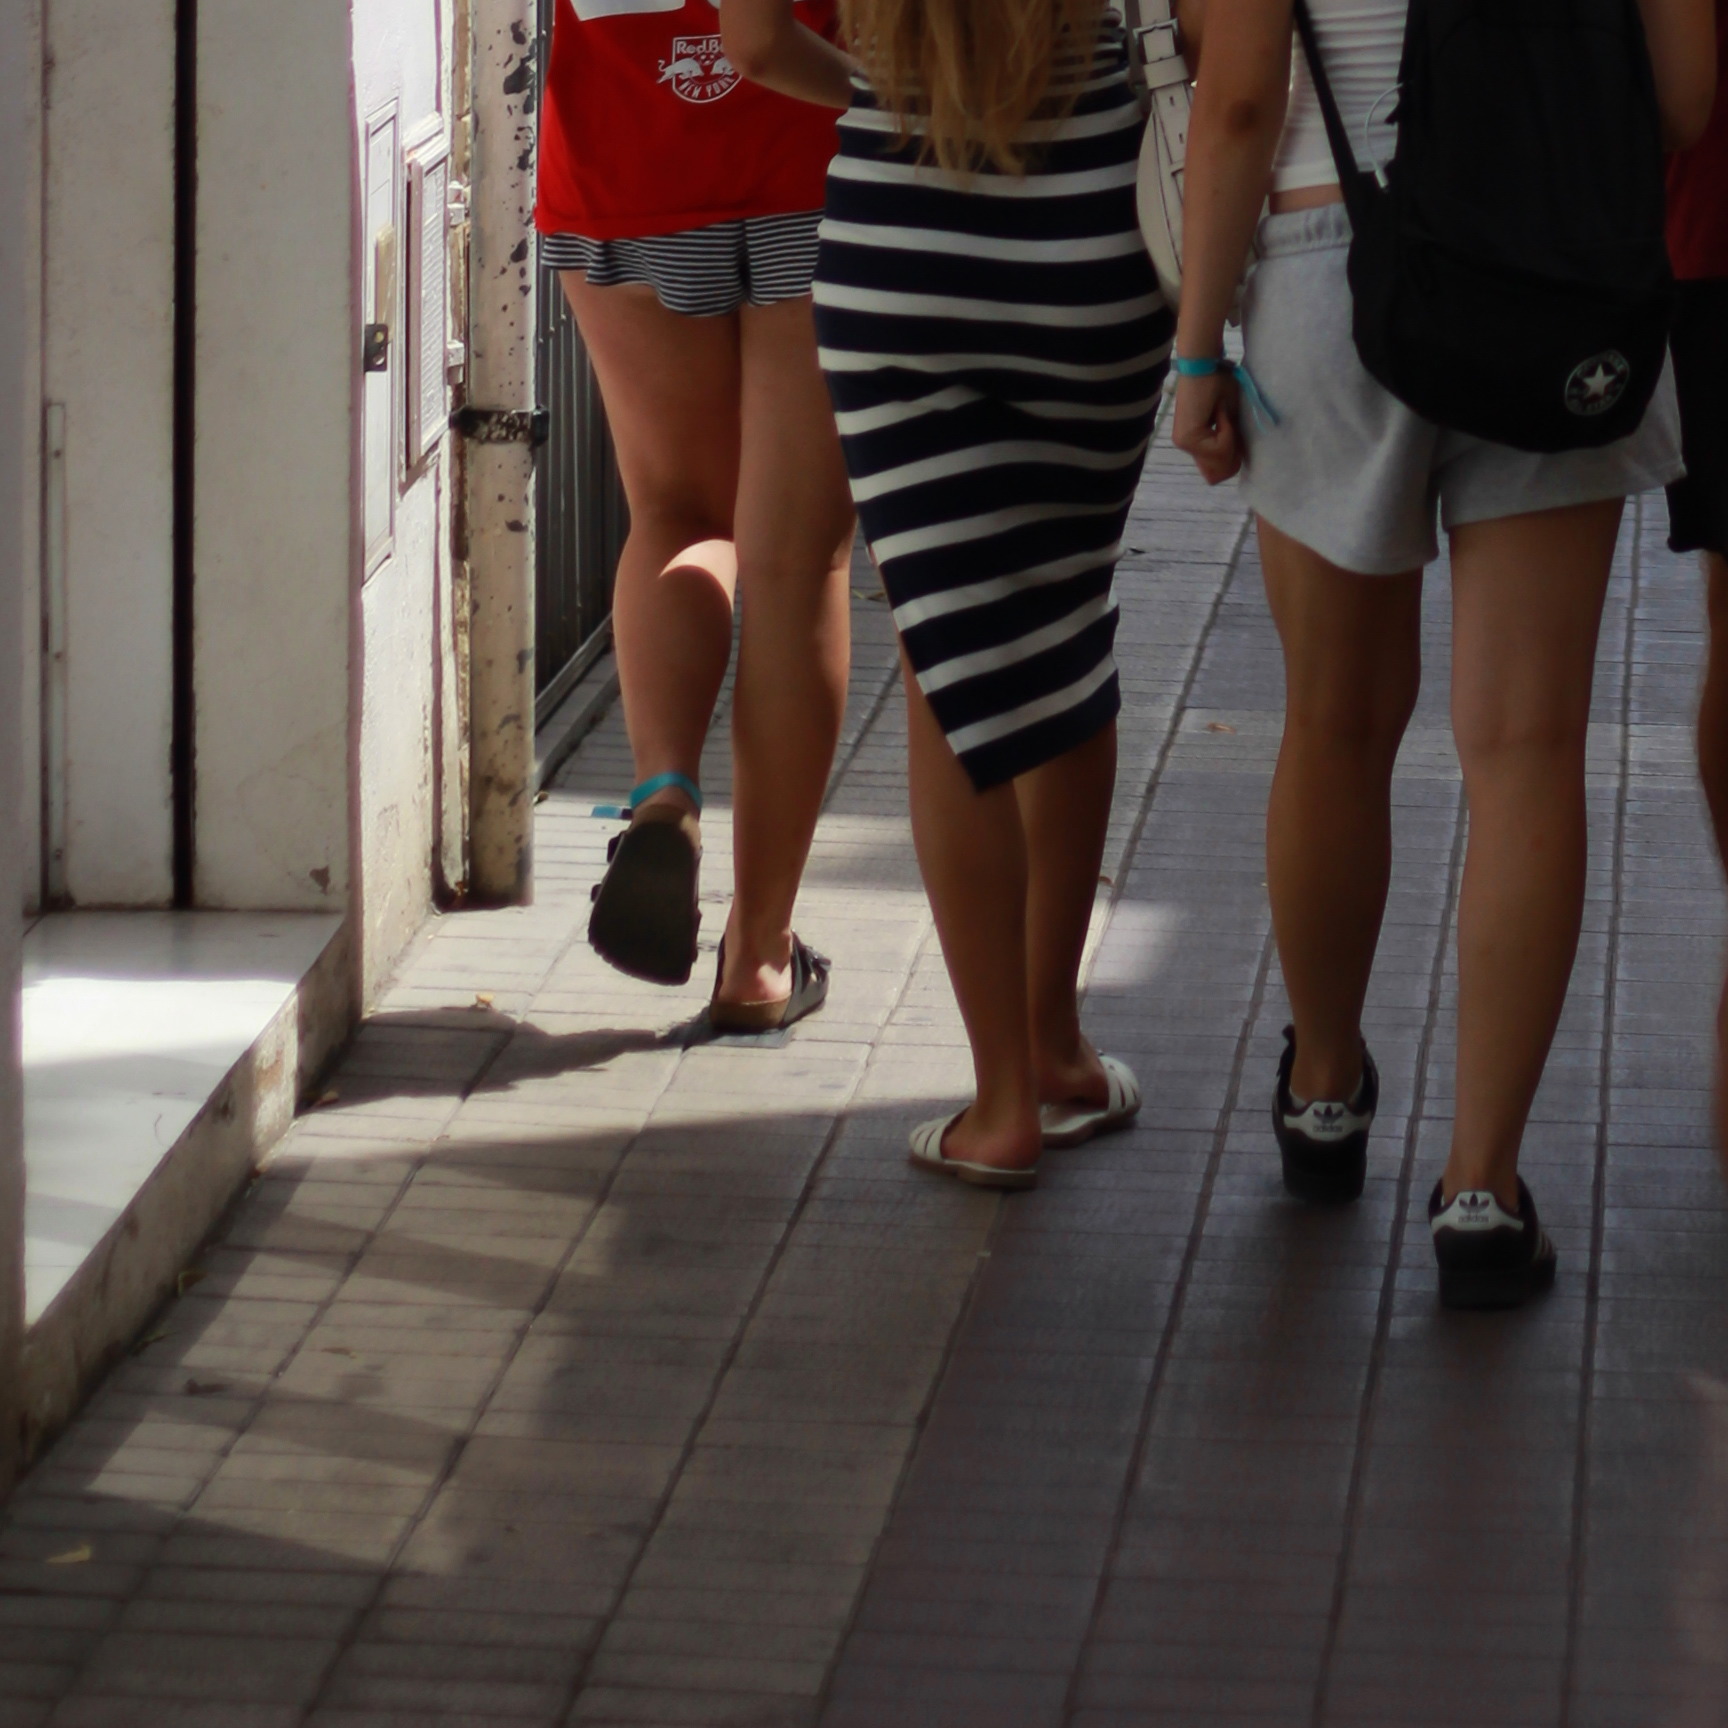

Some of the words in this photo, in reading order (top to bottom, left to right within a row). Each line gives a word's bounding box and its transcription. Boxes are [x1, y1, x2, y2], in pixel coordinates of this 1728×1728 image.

[678, 80, 702, 99] NEW
[706, 76, 735, 98] YORK
[1312, 1124, 1344, 1133] adidas
[1458, 1213, 1490, 1224] adidas
